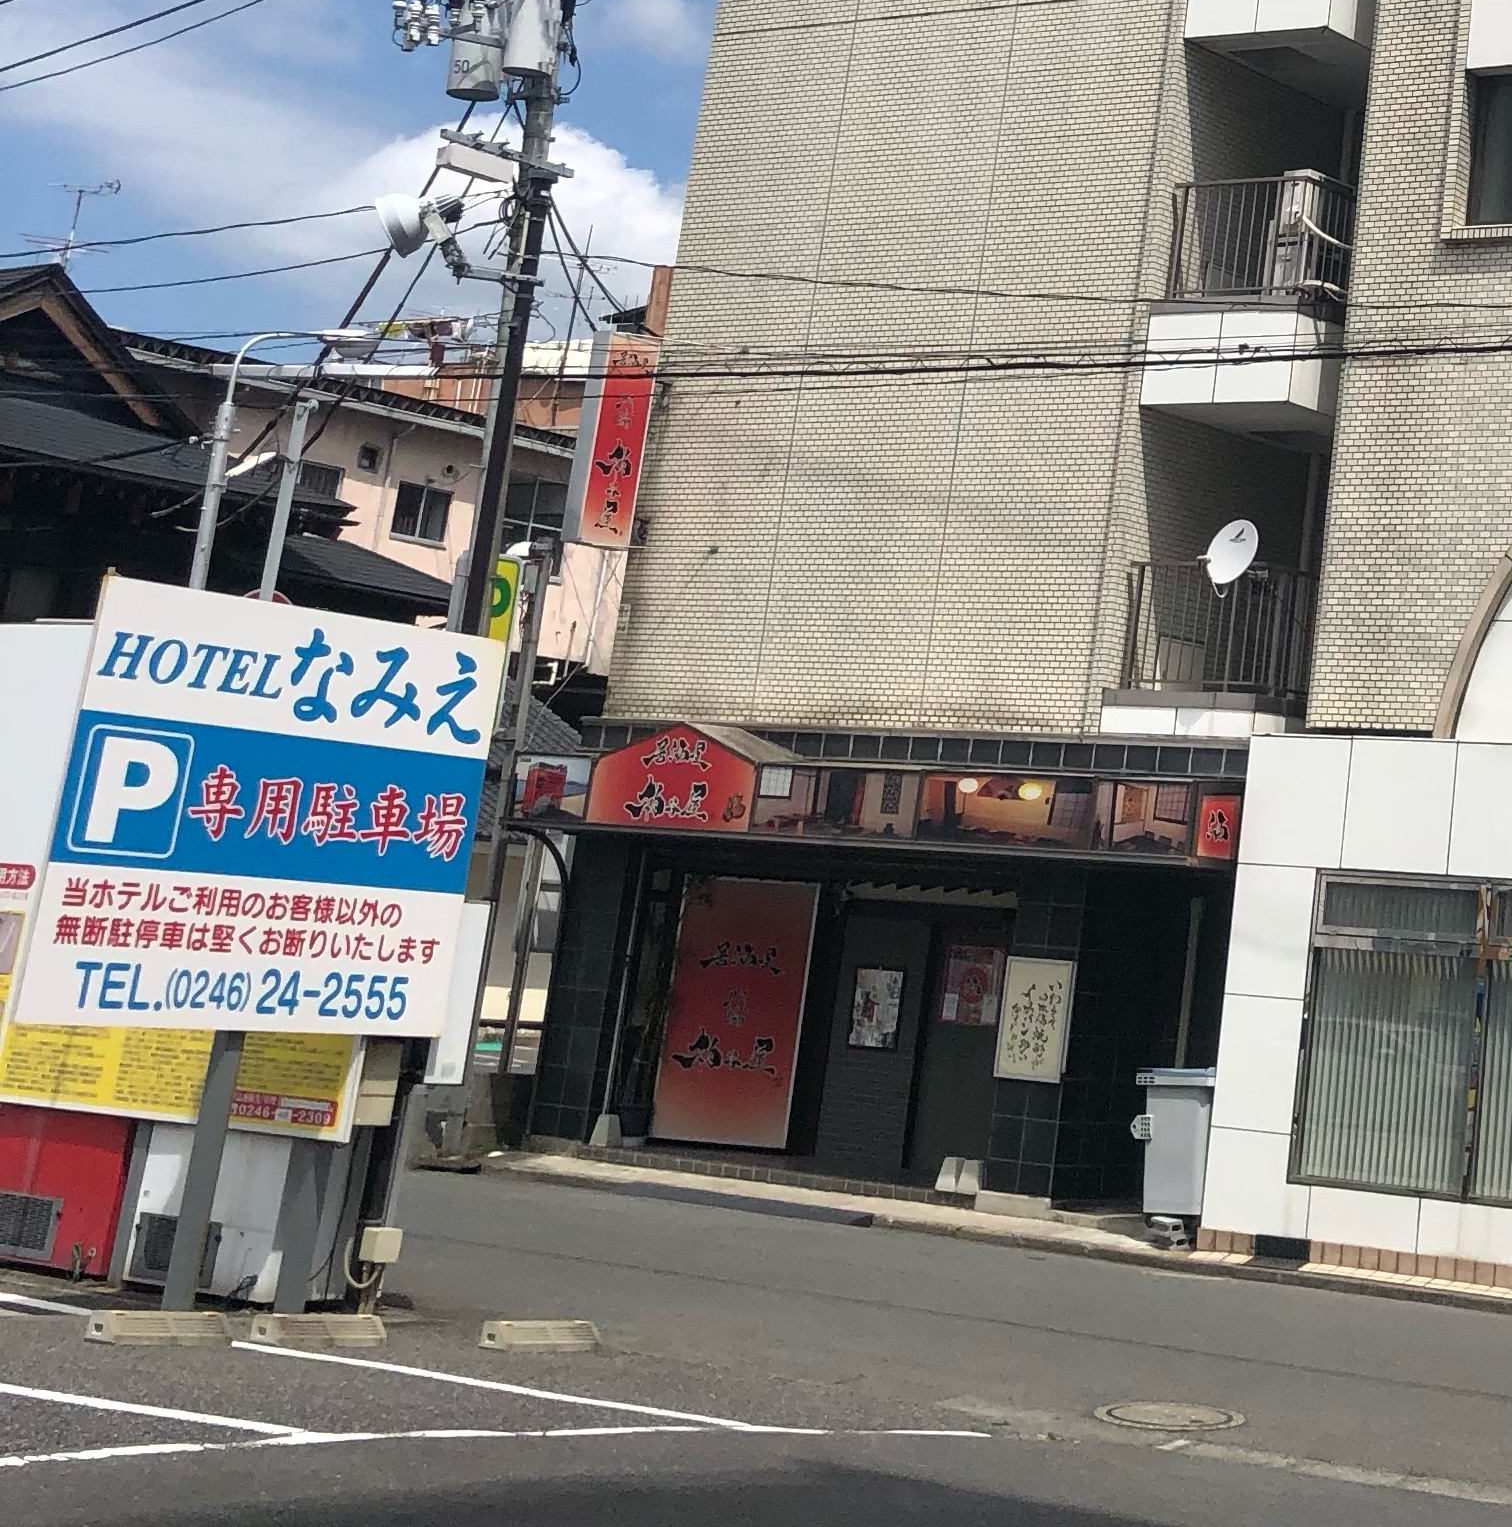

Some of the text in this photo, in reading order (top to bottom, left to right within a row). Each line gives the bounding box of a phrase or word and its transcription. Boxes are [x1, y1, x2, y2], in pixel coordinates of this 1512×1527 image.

[454, 60, 470, 74] 50
[97, 628, 481, 744] HOTEL なみえ
[85, 736, 467, 861] P 専用駐車場
[61, 877, 402, 928] 当ホテルご利用のお客様以外の
[53, 915, 440, 964] 無断駐停車は堅くお断りいたします
